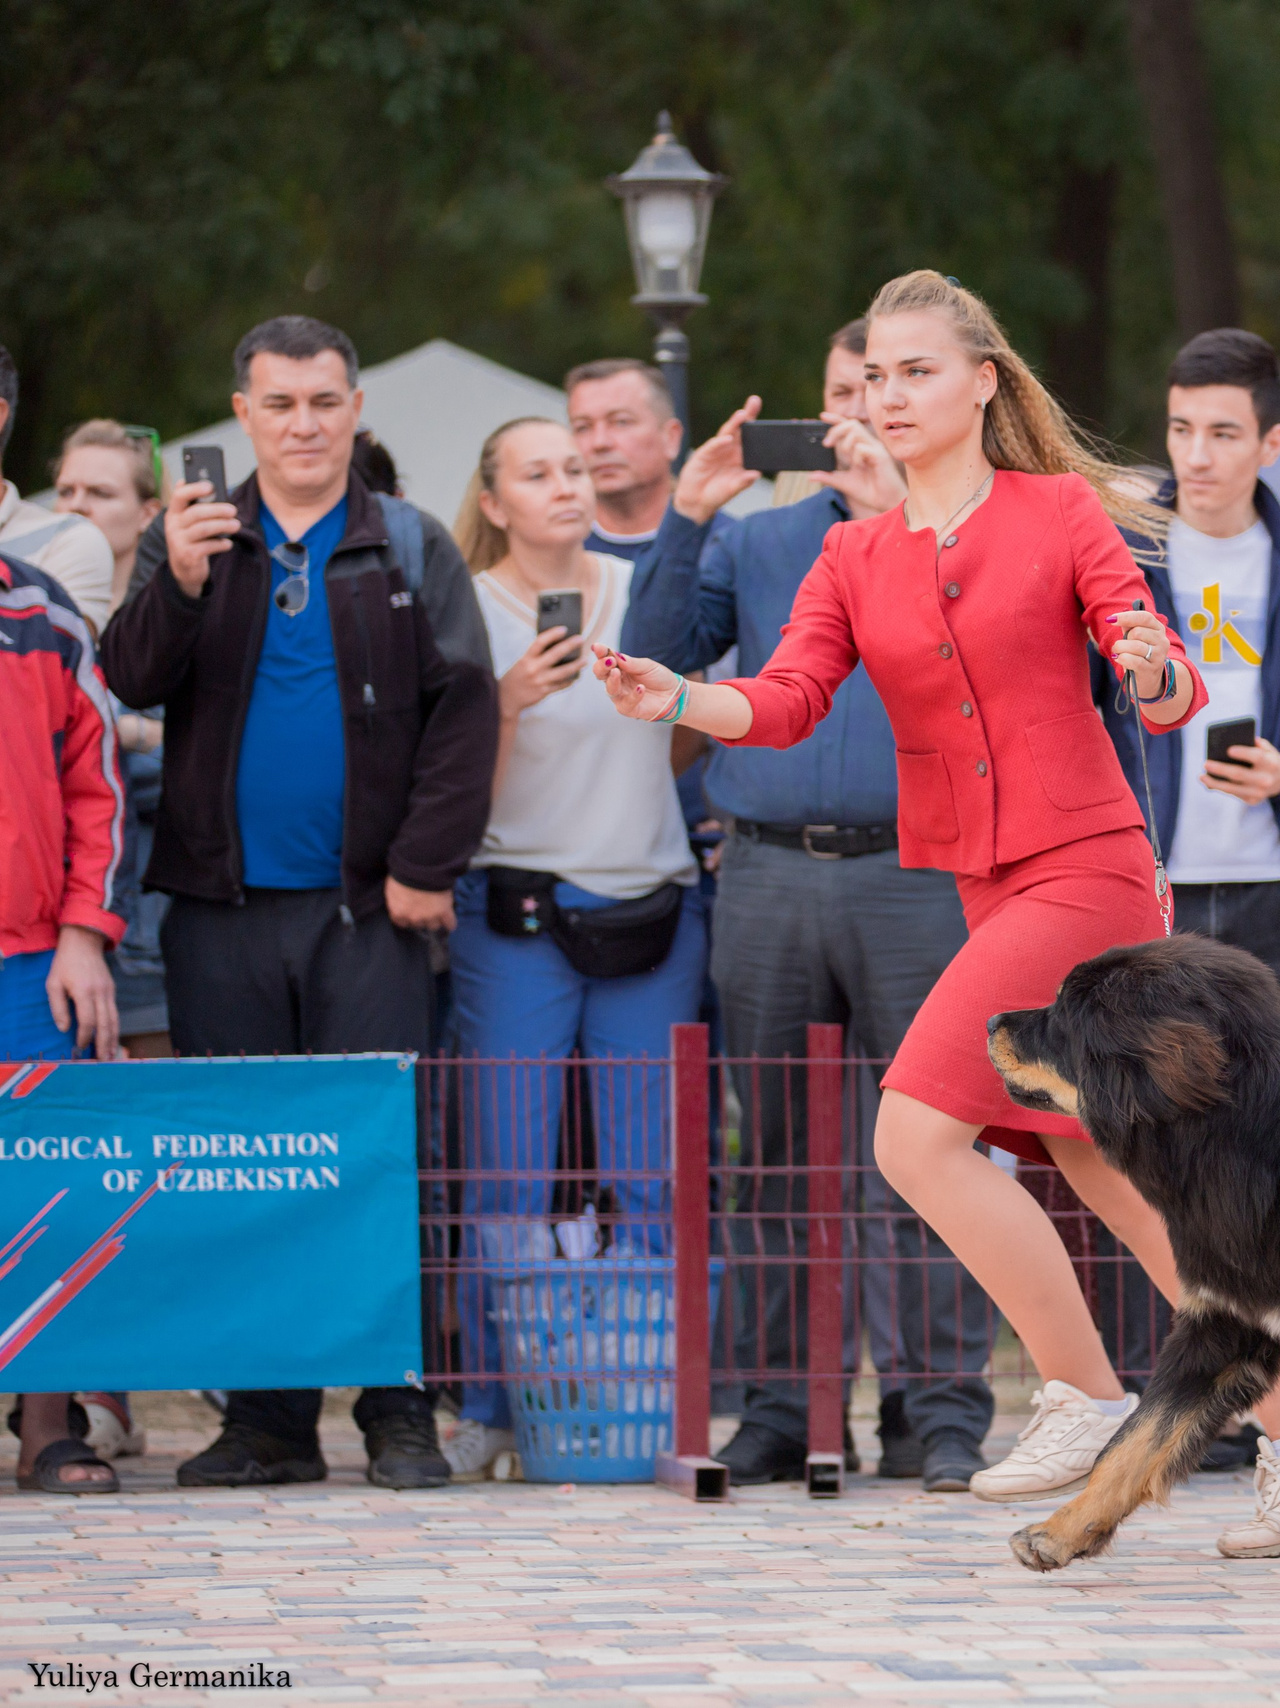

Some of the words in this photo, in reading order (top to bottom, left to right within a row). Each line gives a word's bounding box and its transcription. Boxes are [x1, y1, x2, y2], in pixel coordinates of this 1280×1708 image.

[0, 1136, 132, 1160] LOGICAL
[152, 1132, 339, 1158] FEDERATION
[102, 1169, 143, 1193] OF
[156, 1166, 340, 1192] UZBEKISTAN
